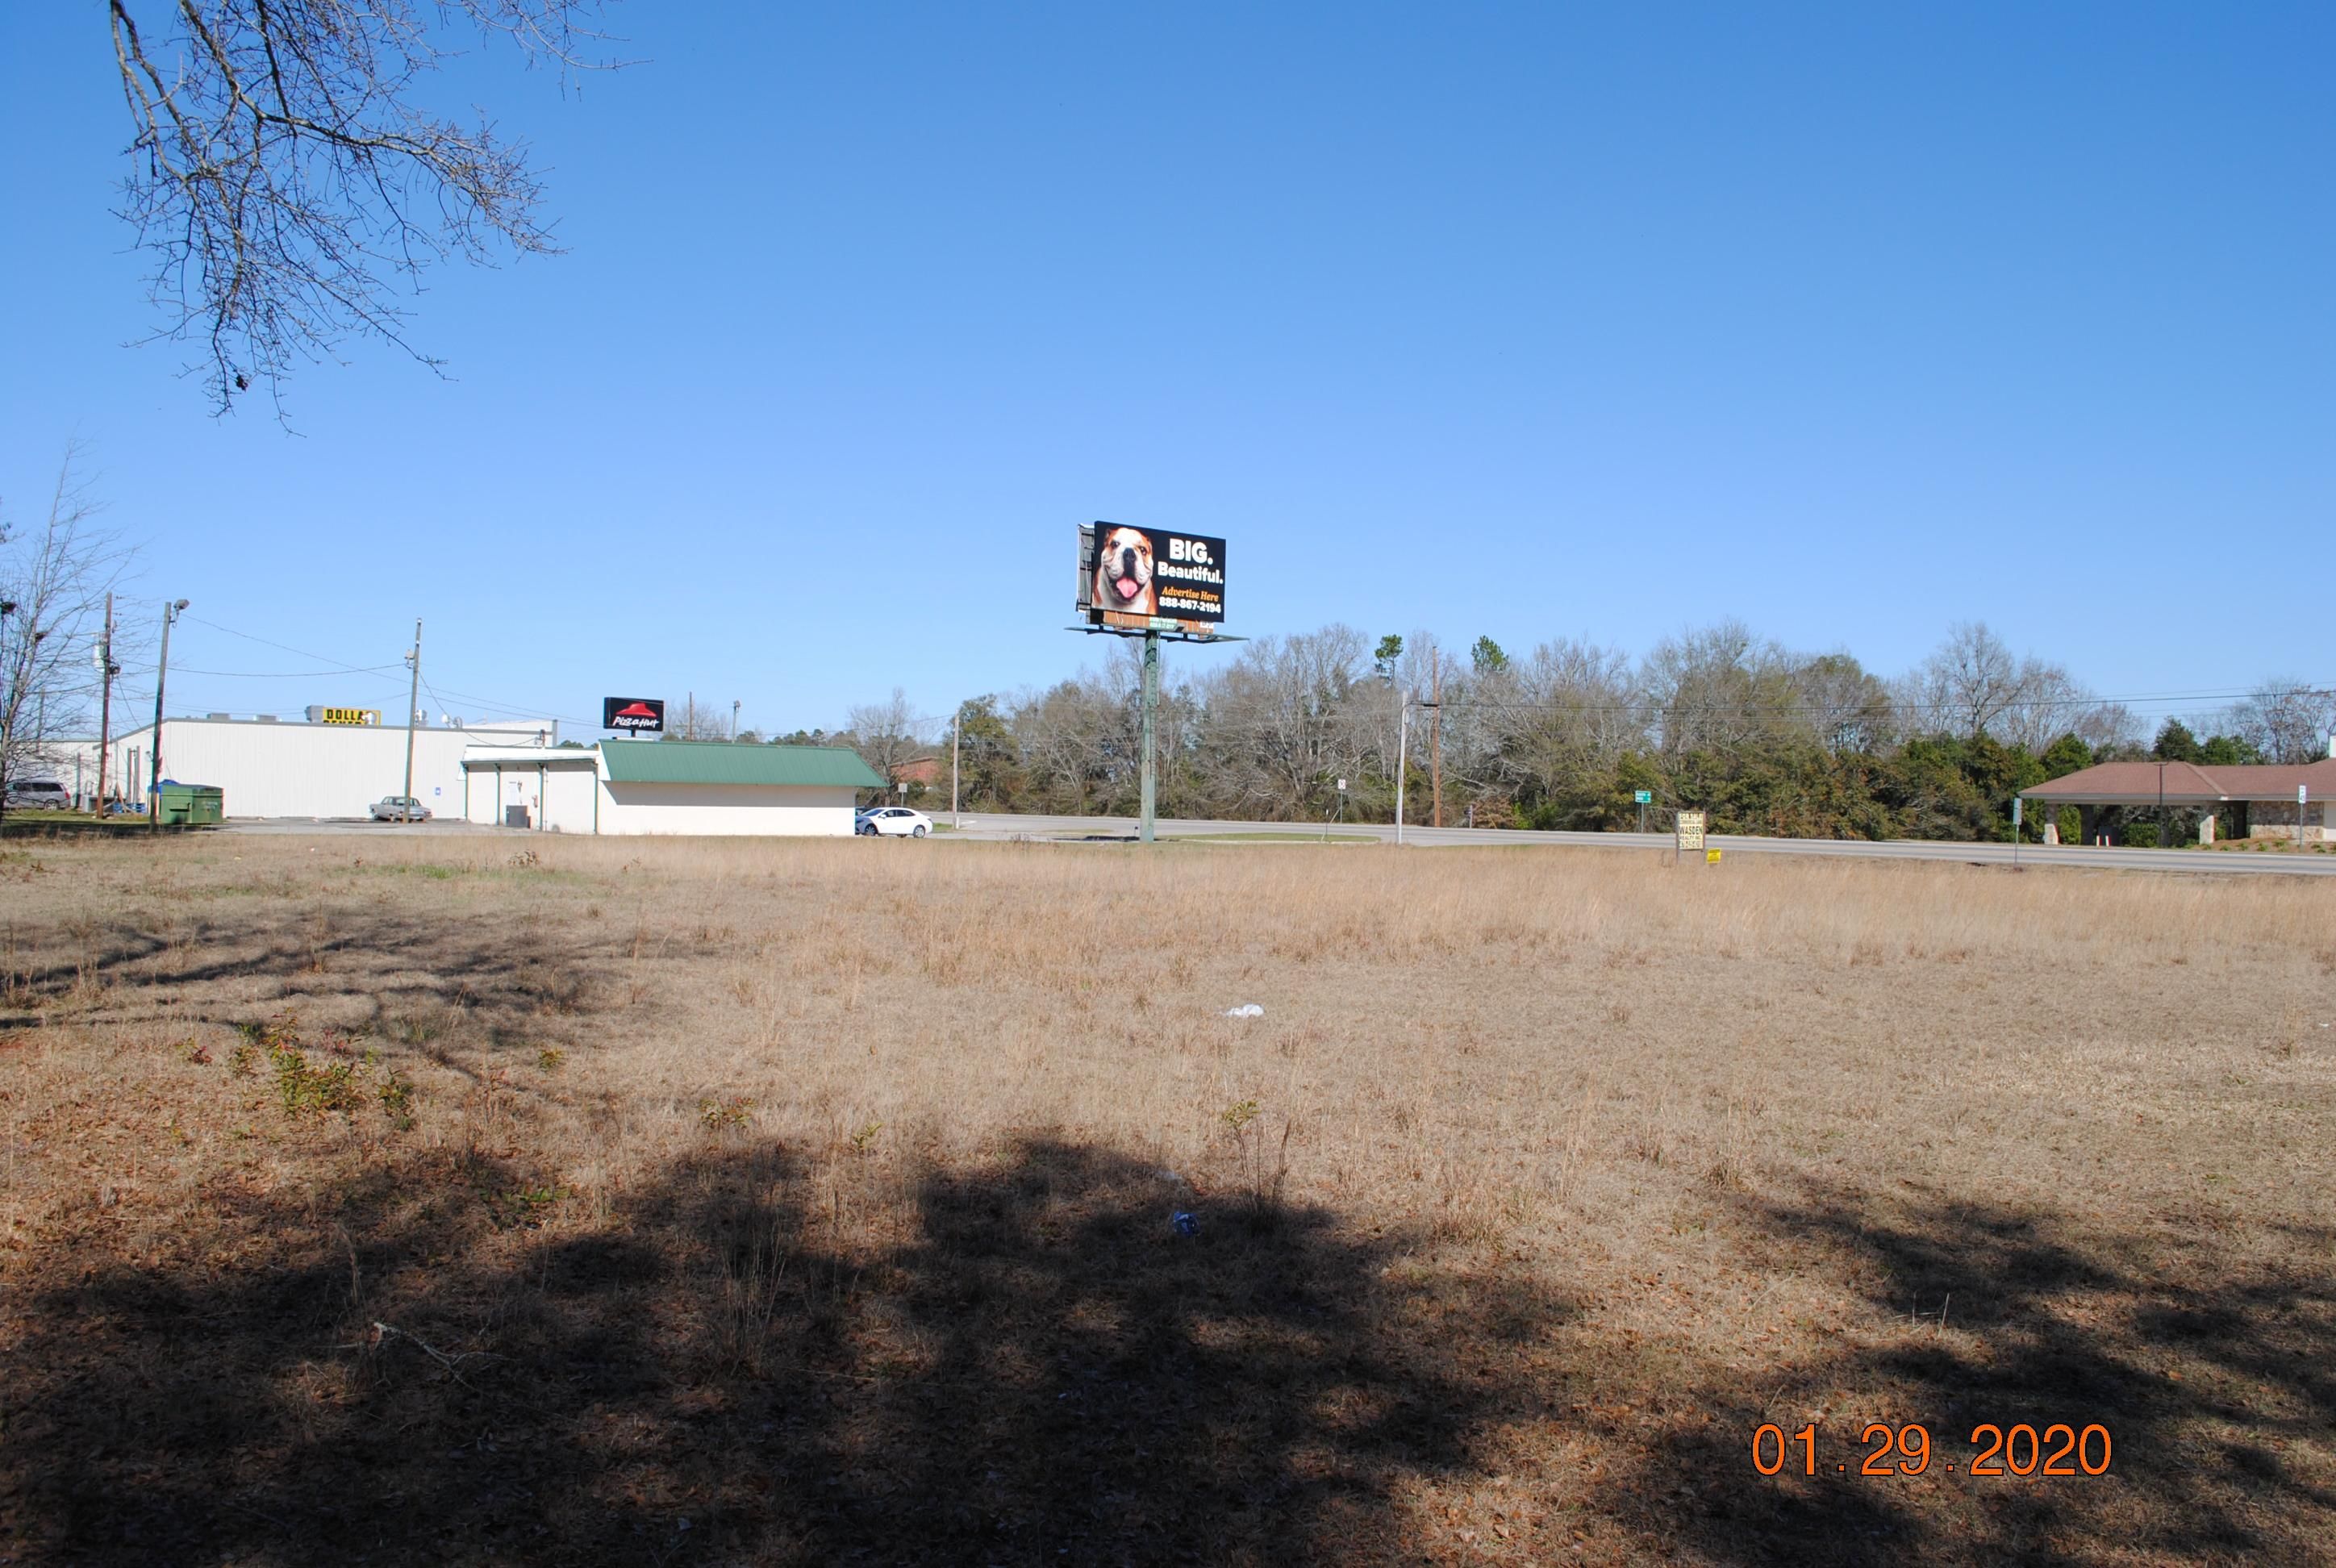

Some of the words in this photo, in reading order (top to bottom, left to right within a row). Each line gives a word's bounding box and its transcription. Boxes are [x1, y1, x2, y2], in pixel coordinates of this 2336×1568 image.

[1170, 538, 1213, 565] BIG.
[1158, 561, 1224, 584] Beautiful.
[1162, 586, 1199, 598] Advertise
[1200, 590, 1219, 603] Here
[1159, 596, 1221, 613] 888-867-2194
[612, 716, 639, 726] Pizza
[639, 718, 660, 728] Hut
